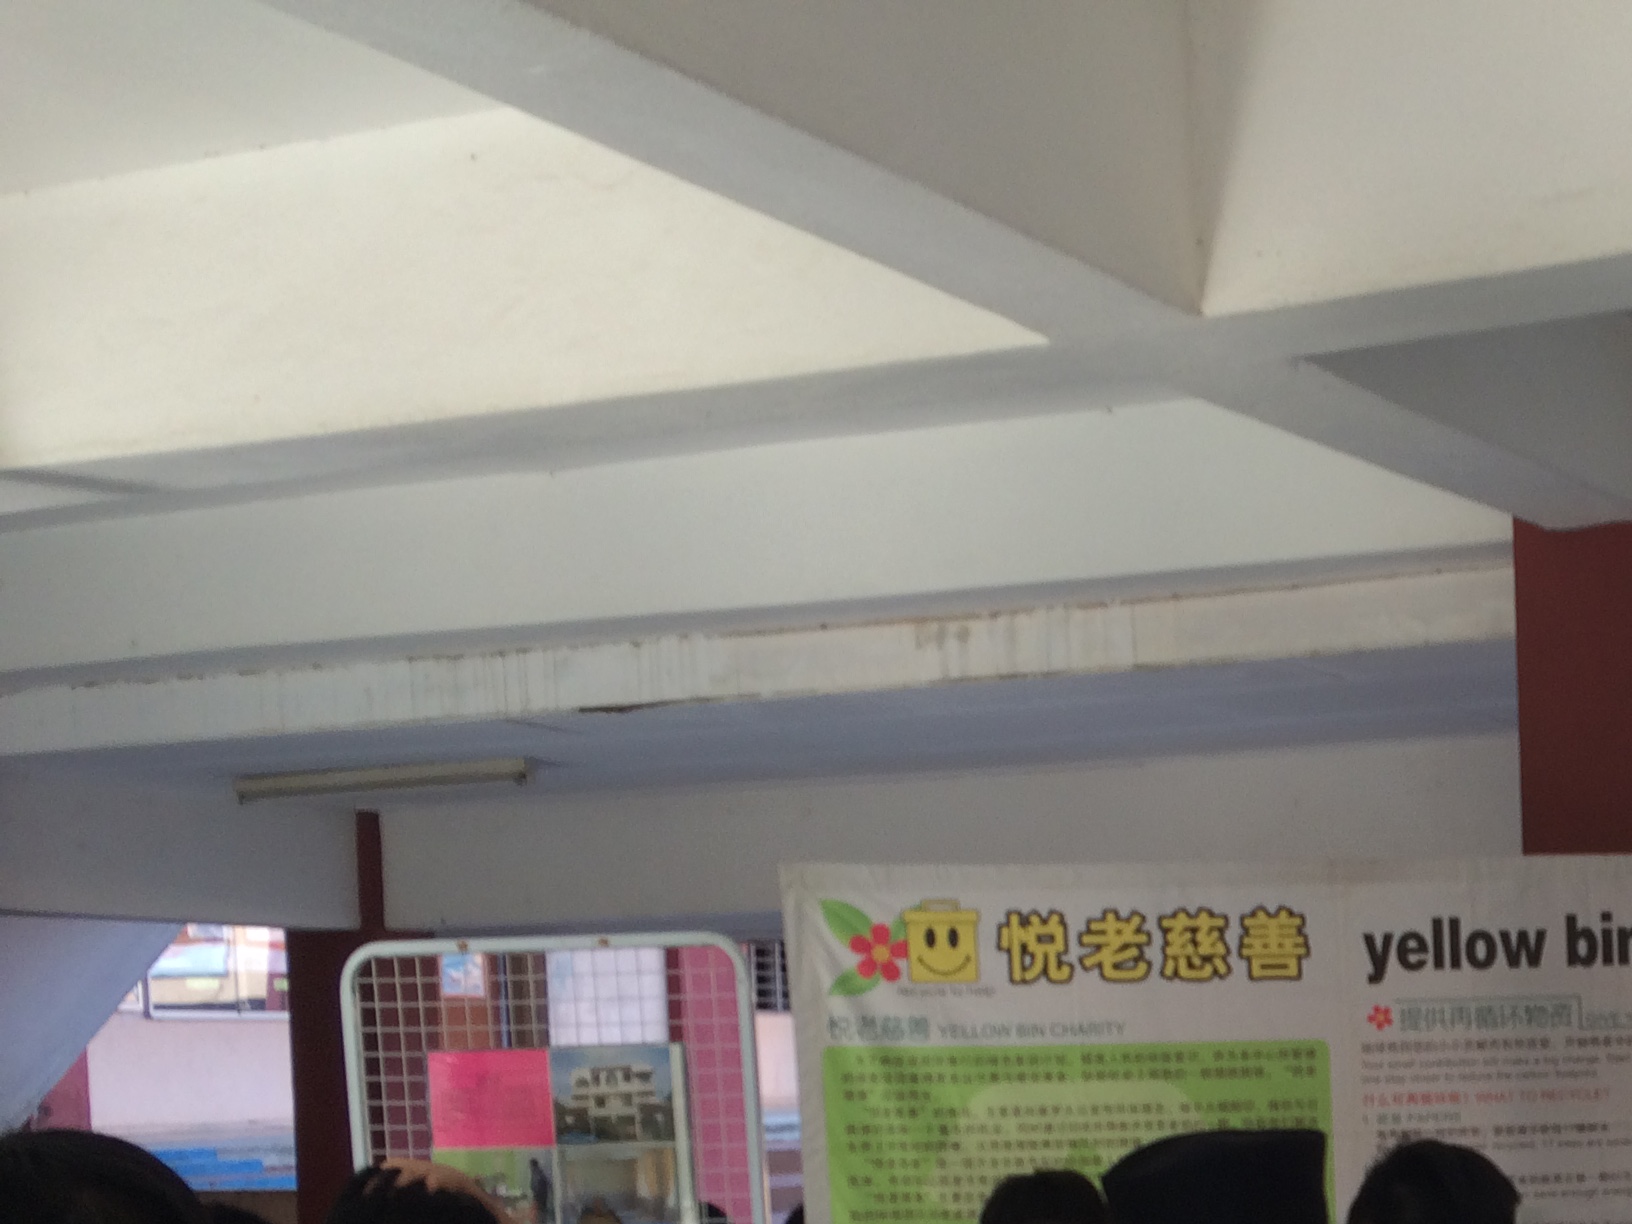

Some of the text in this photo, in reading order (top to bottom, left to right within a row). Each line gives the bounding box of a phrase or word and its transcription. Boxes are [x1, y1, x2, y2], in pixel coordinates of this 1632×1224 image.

[997, 906, 1310, 985] 悦老慈善
[1363, 916, 1547, 984] yellow
